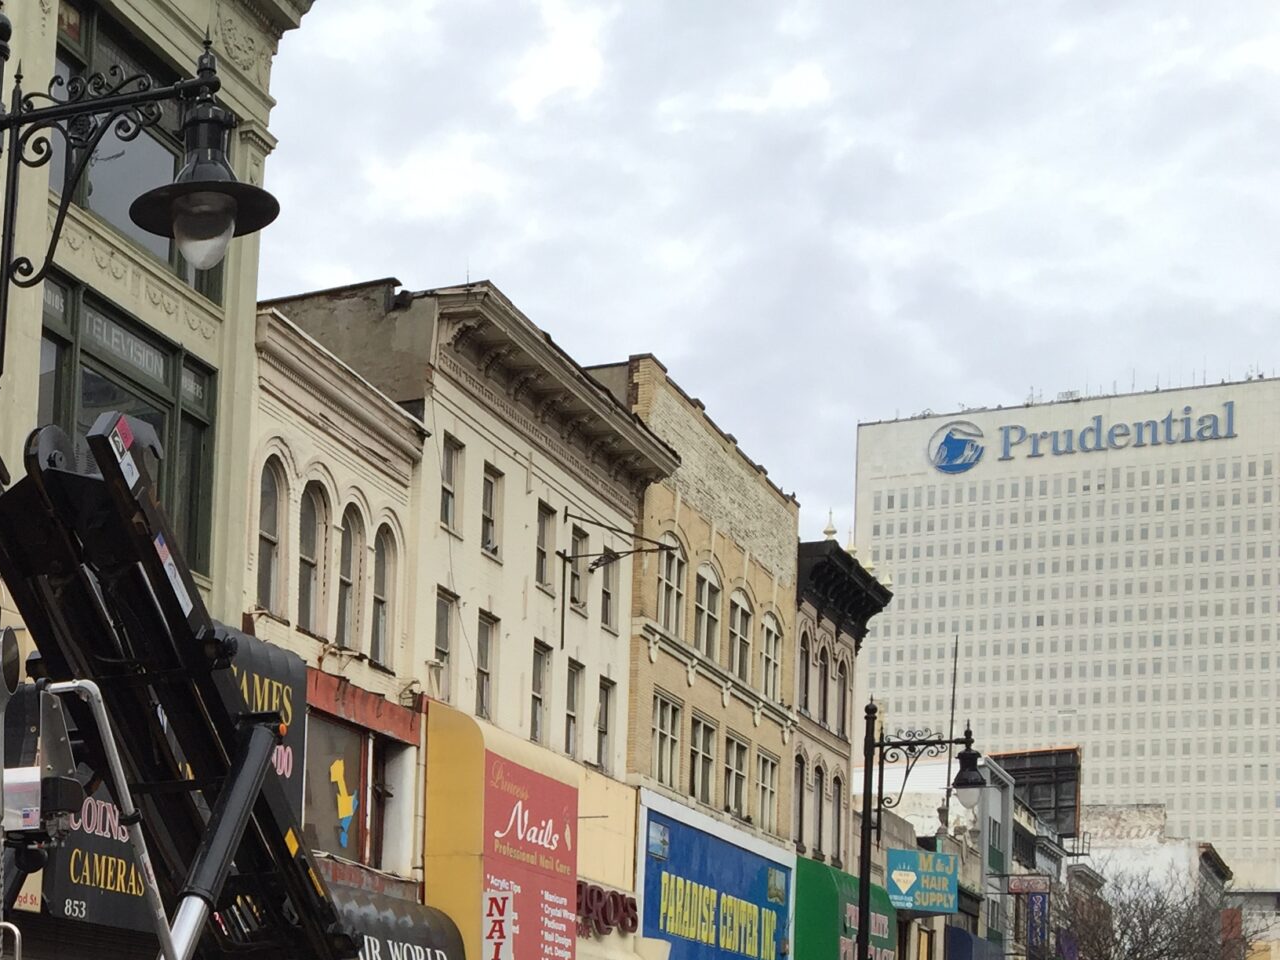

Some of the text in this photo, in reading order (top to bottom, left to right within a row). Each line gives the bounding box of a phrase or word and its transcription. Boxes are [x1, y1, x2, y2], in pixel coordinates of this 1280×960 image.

[998, 400, 1239, 462] Prudential
[232, 666, 293, 727] AMES
[494, 800, 560, 850] Nails
[70, 848, 145, 897] CAMERAS
[494, 838, 537, 866] Professional
[555, 858, 572, 876] Care
[919, 852, 934, 873] M
[945, 855, 955, 875] J
[914, 890, 955, 909] SUPPLY
[921, 874, 949, 892] HAIR
[64, 898, 87, 918] 853
[659, 870, 718, 948] PARADISE
[719, 891, 759, 960] CENTER
